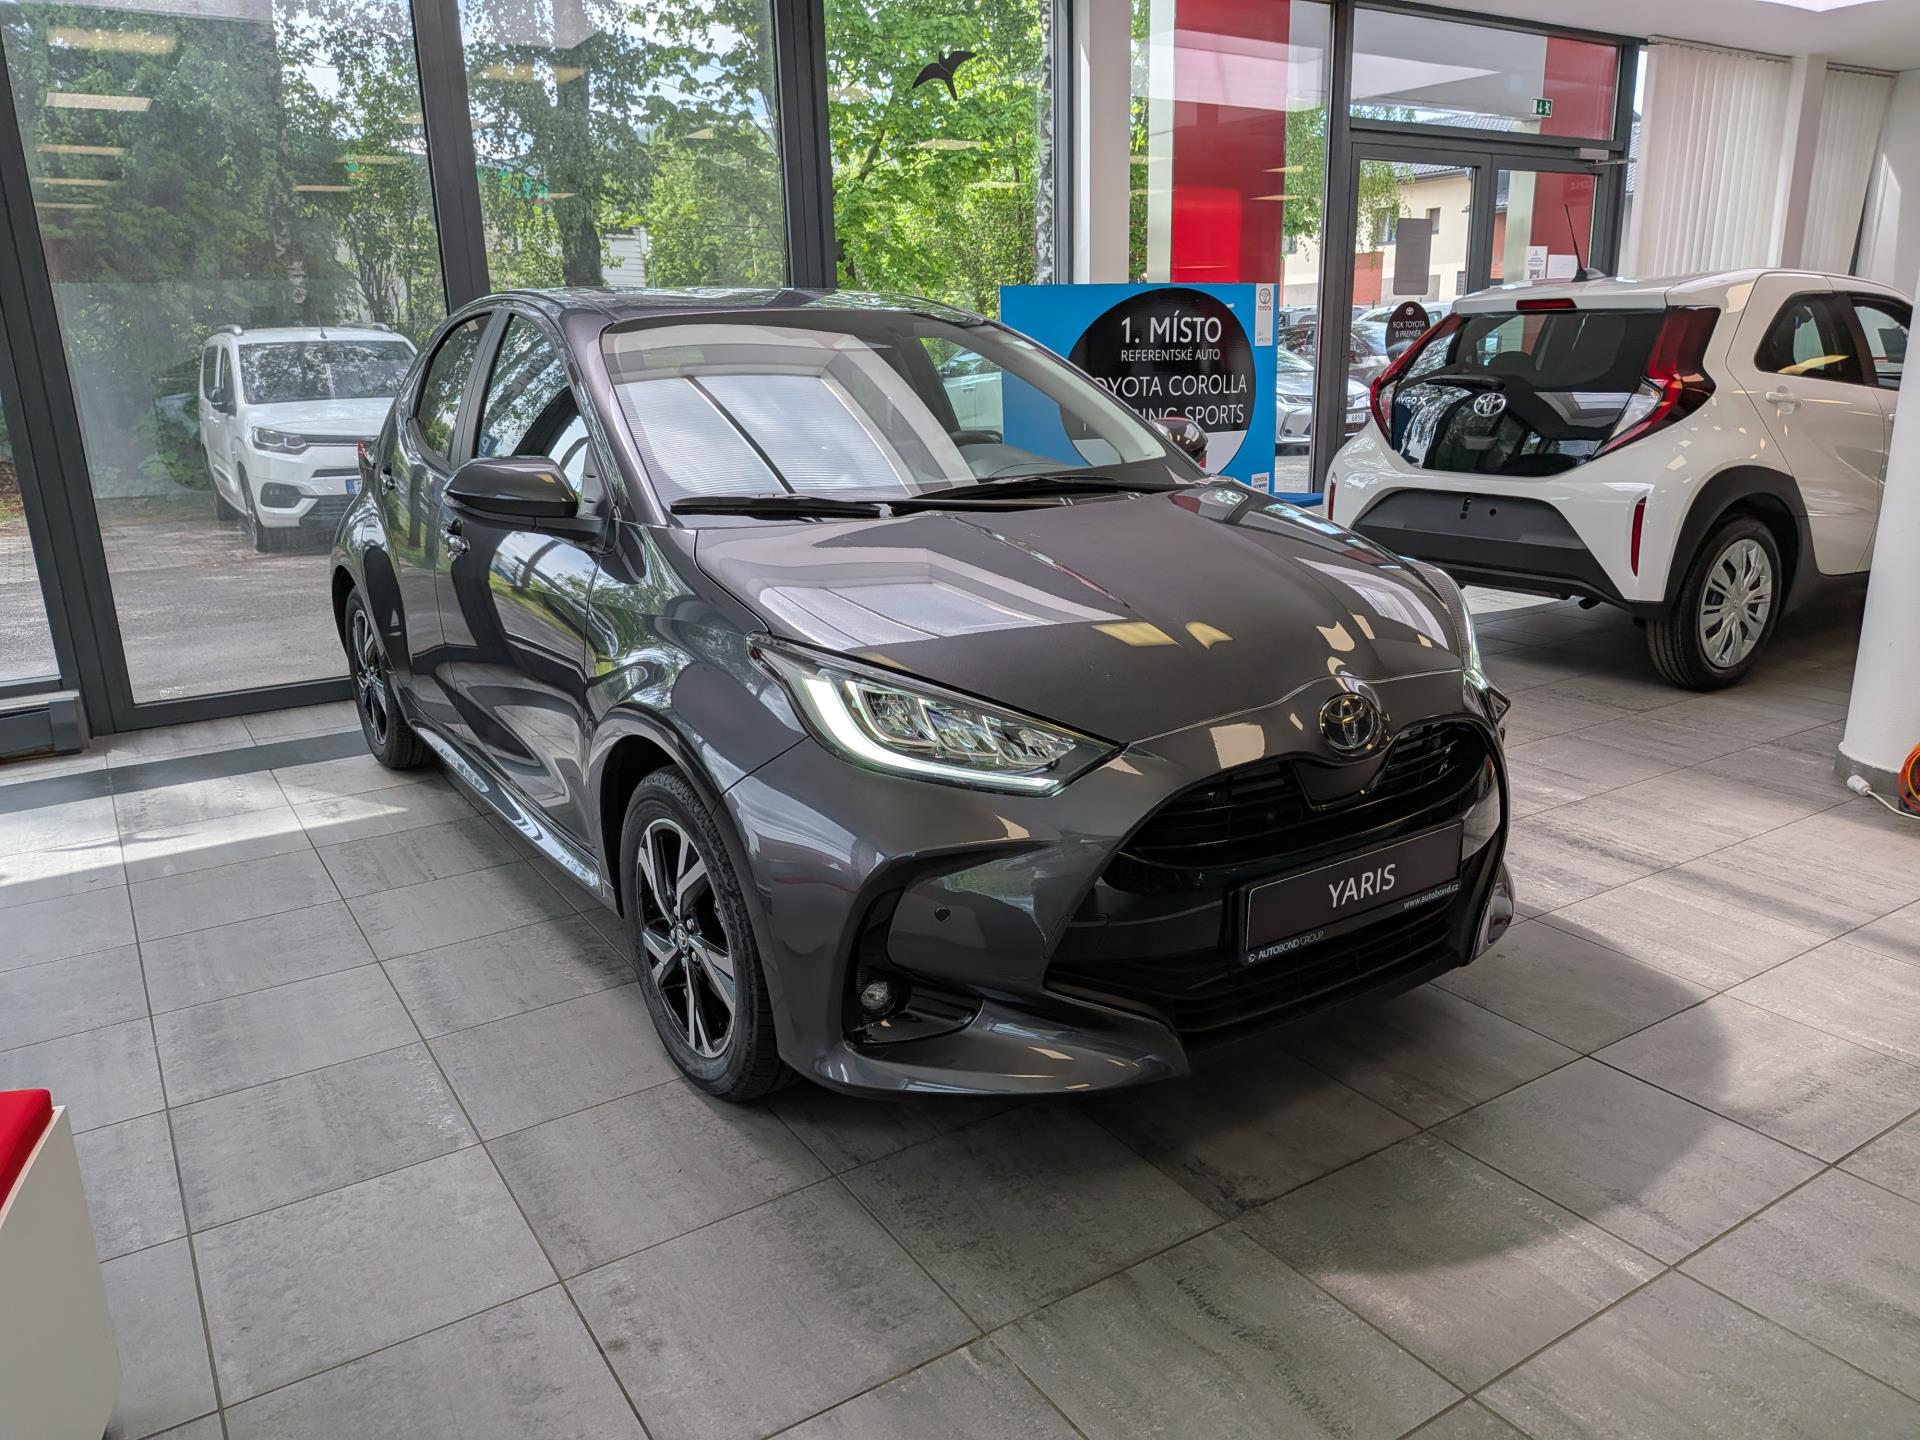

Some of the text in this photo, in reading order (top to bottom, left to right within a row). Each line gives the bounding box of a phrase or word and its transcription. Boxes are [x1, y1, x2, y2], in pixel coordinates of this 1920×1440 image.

[1121, 310, 1222, 344] 1. MÍSTO
[1404, 320, 1425, 328] TOYOTA
[1121, 346, 1221, 362] REFERENTSKÉ AUTO
[1094, 374, 1247, 398] OYOTA COROLLA
[1395, 396, 1429, 406] AYGO X
[1184, 404, 1244, 425] SPORTS
[1328, 863, 1396, 909] YARIS
[1403, 883, 1459, 909] www.autobond.cz
[1258, 930, 1324, 960] AUTOBOND GROUP
